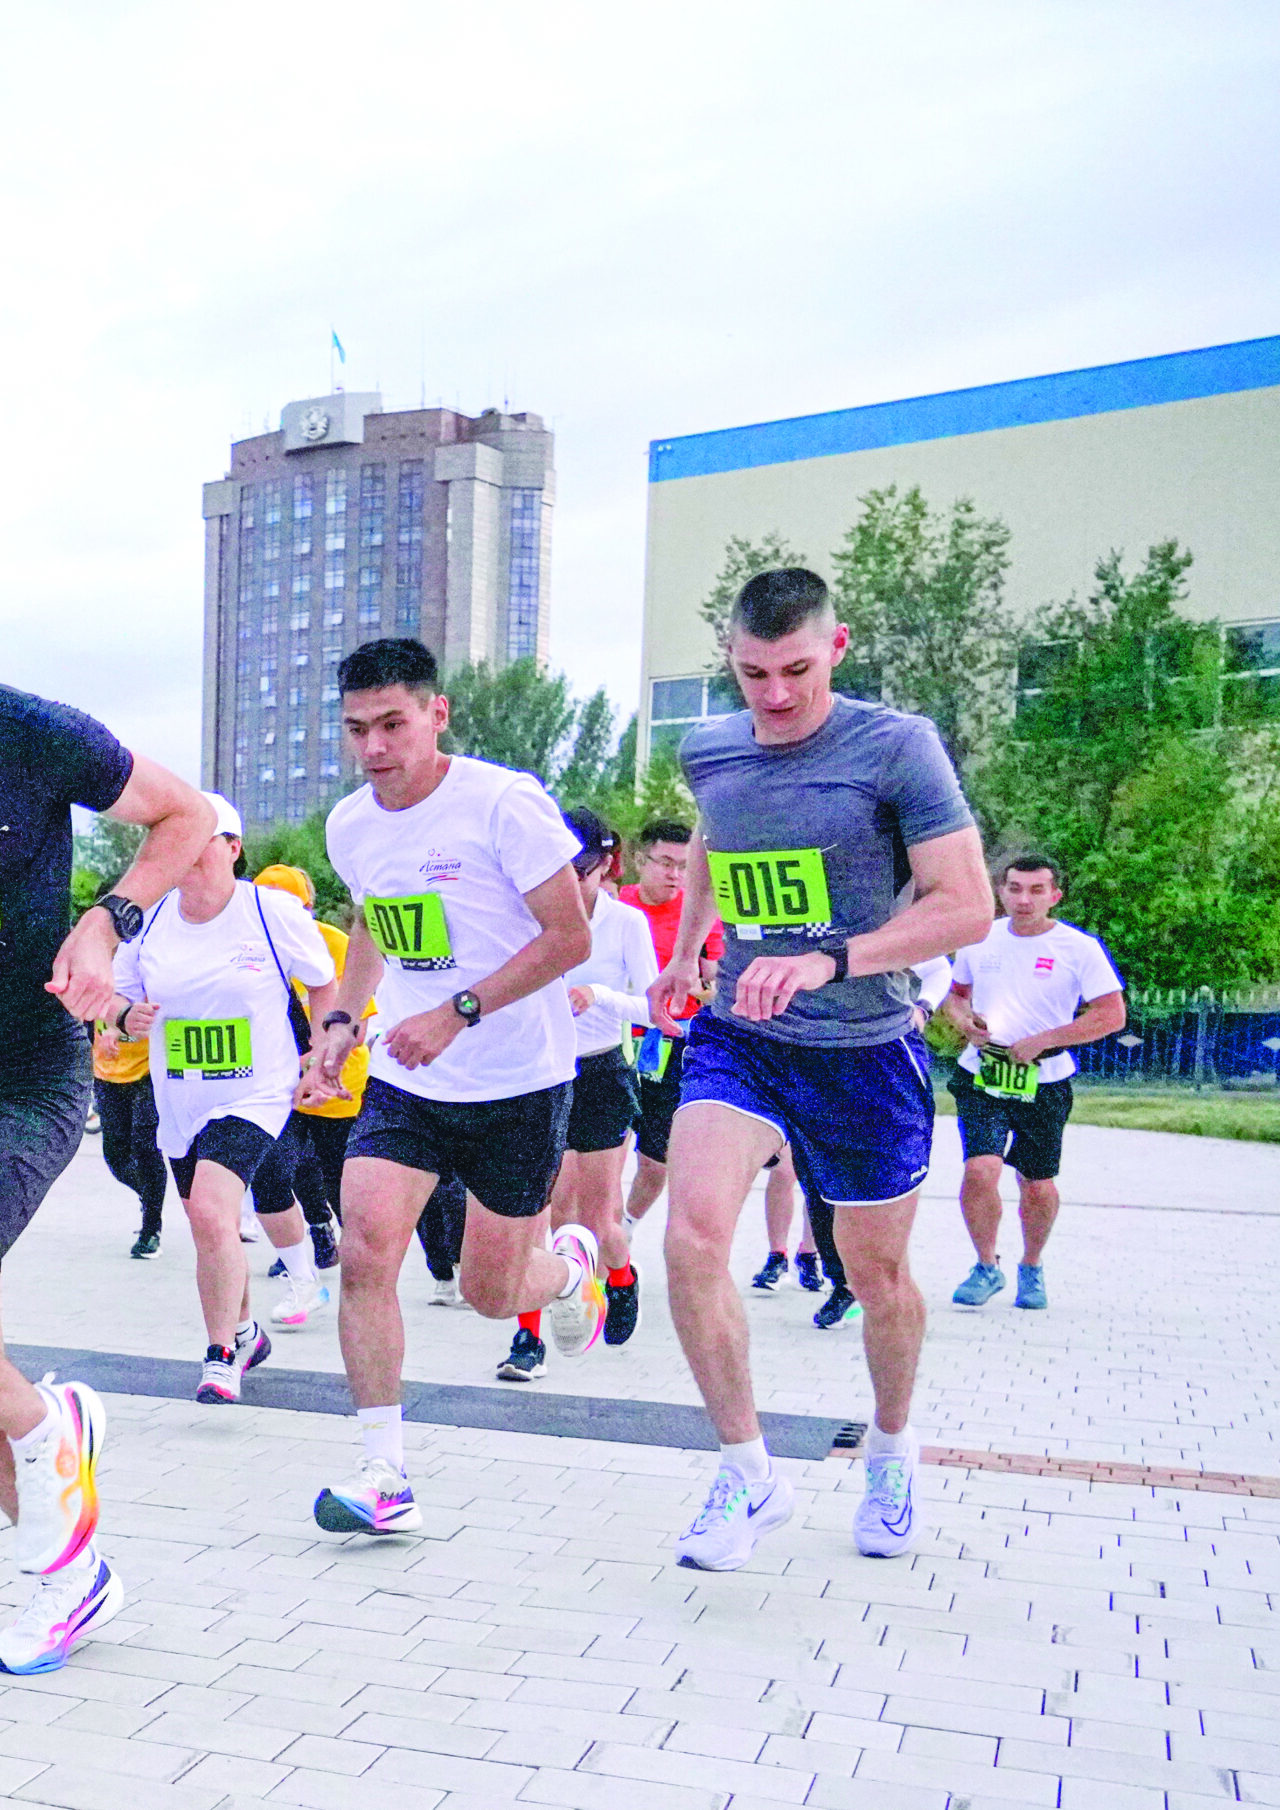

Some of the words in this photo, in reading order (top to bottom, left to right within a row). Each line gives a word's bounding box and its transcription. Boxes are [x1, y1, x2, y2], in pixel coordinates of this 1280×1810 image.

[729, 860, 810, 918] 015
[373, 902, 424, 952] 017
[184, 1024, 238, 1065] 001
